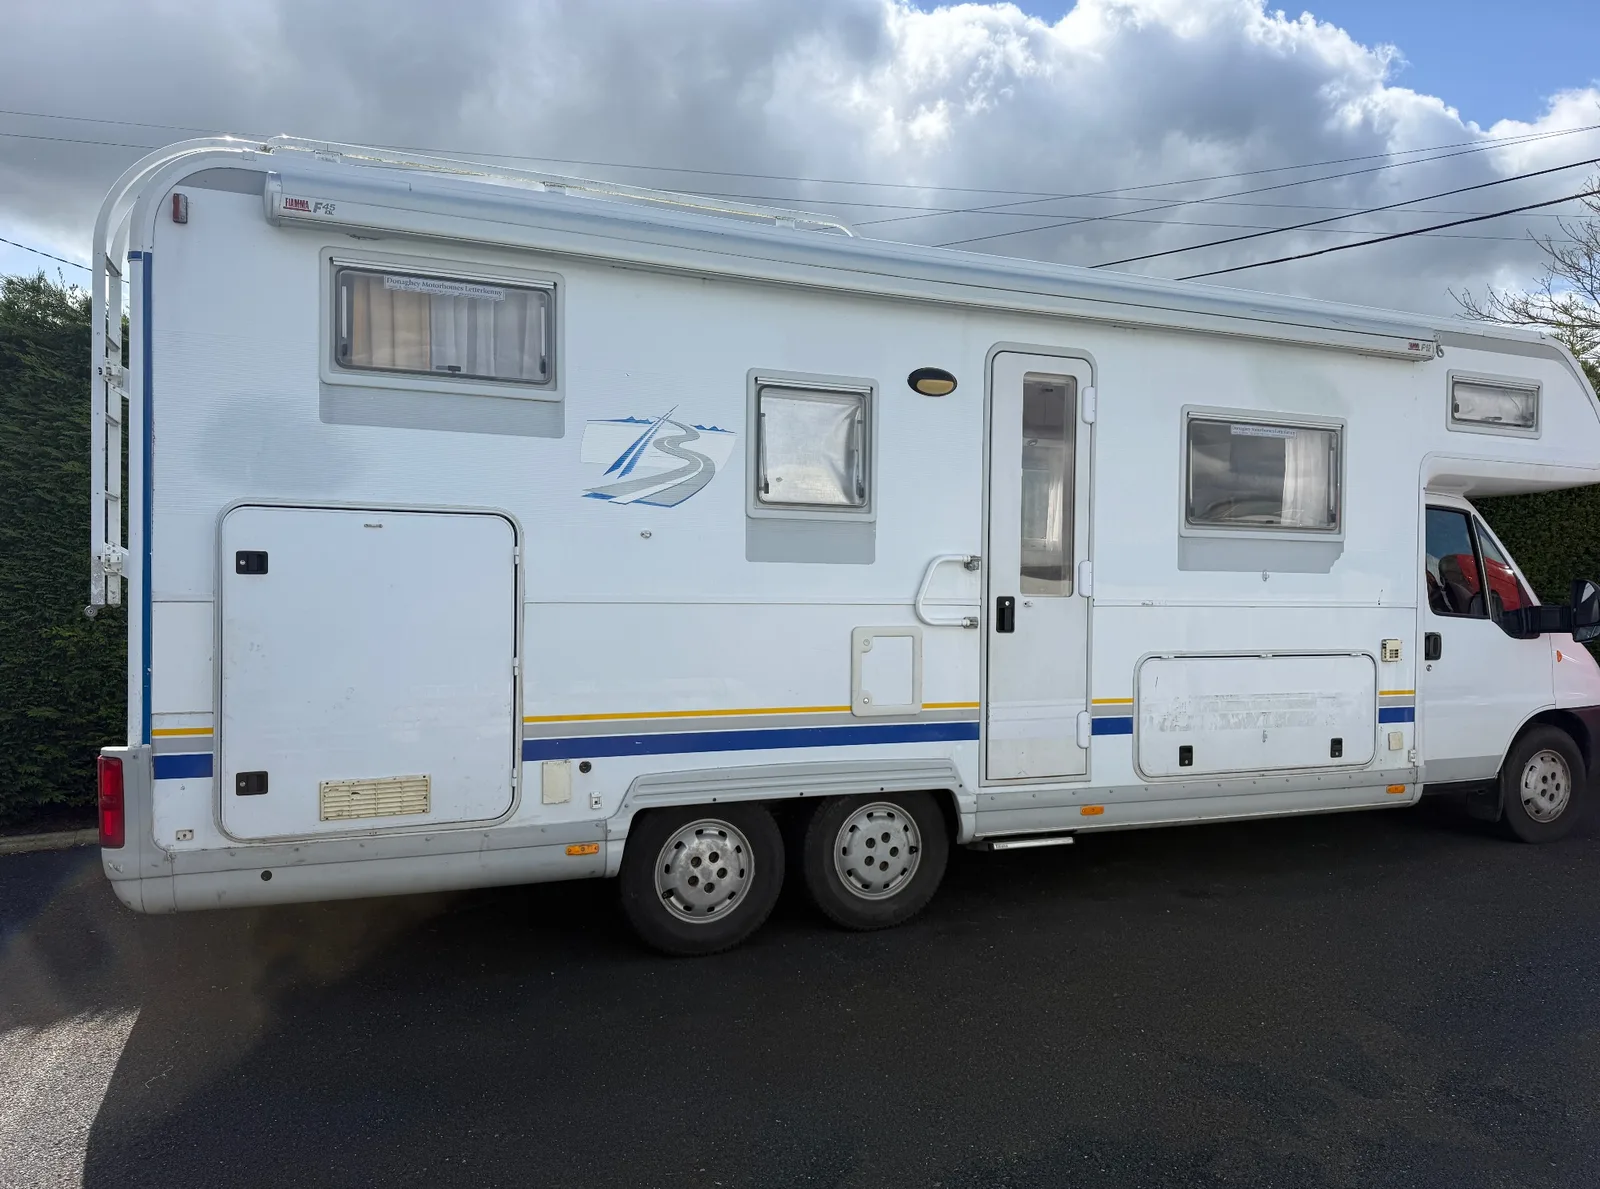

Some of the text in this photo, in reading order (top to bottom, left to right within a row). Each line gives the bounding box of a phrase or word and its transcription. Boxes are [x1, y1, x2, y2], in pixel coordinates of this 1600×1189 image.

[285, 197, 336, 213] FIAMMA F45
[386, 277, 421, 287] Donaghey
[421, 281, 464, 291] Motorhomes
[465, 285, 503, 296] Letterkenny
